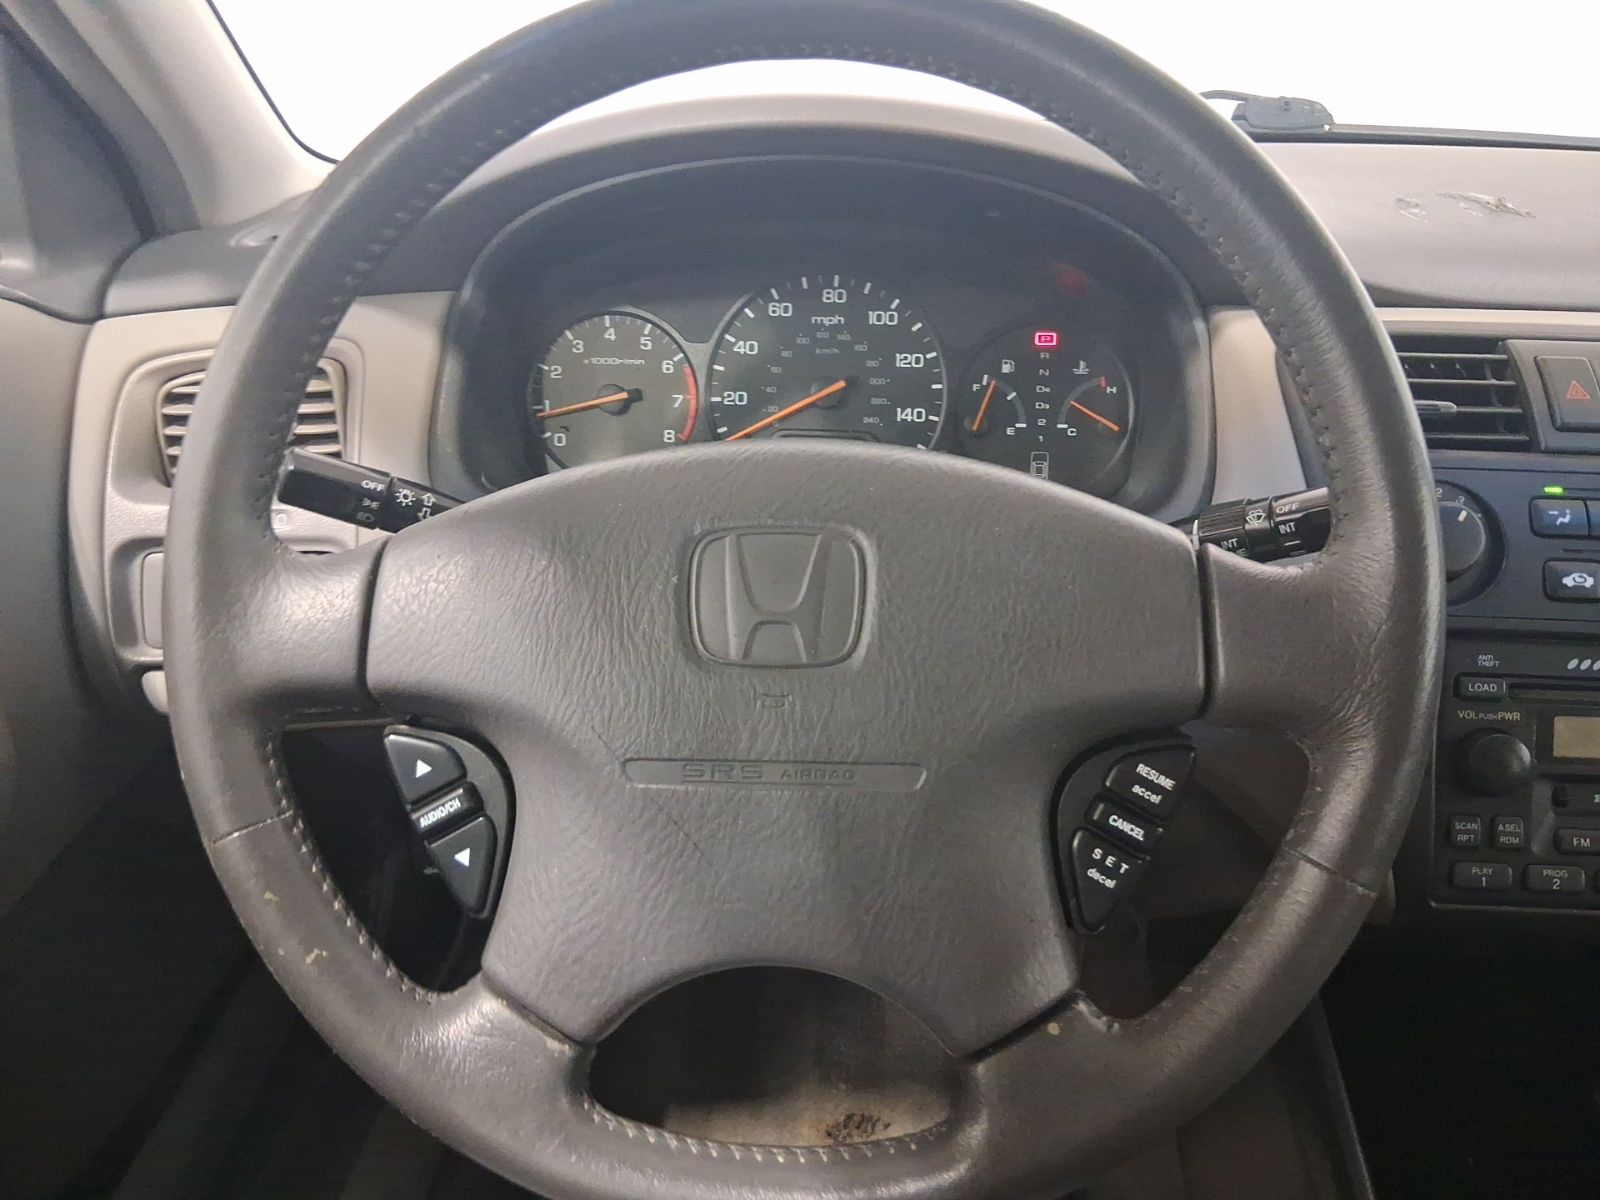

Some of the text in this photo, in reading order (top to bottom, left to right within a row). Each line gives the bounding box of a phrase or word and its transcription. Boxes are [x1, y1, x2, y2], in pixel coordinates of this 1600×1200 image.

[822, 289, 847, 303] 80
[768, 303, 793, 317] 60
[811, 315, 845, 327] mph
[868, 311, 898, 326] 100
[604, 327, 616, 341] 4
[572, 340, 584, 353] 3
[639, 337, 652, 350] 5
[733, 341, 758, 355] 40
[895, 354, 924, 368] 120
[1040, 352, 1050, 360] R
[550, 366, 562, 379] 2
[662, 360, 674, 374] 6
[972, 384, 982, 392] F
[1106, 386, 1117, 394] H
[672, 395, 683, 408] 7
[723, 392, 748, 405] 20
[545, 400, 550, 413] 1
[1035, 402, 1050, 410] D3
[896, 408, 926, 422] 140
[1037, 418, 1047, 426] 2
[663, 430, 675, 443] 8
[1006, 427, 1016, 436] E
[1067, 428, 1077, 436] C
[554, 433, 566, 446] 0
[1038, 435, 1044, 443] 1
[362, 480, 385, 492] OFF
[1435, 488, 1443, 498] 2
[1276, 502, 1300, 514] OFF
[1278, 521, 1296, 534] INT
[1221, 538, 1238, 550] INT
[1478, 660, 1500, 668] THEFT
[1468, 683, 1497, 692] LOAD
[1458, 710, 1479, 720] VOL
[1498, 712, 1520, 721] PWR
[682, 763, 855, 781] SRS AIRBAG
[1136, 763, 1176, 791] RESUME
[1131, 784, 1163, 804] accel
[419, 797, 461, 828] AUDIO/CH
[1108, 814, 1145, 841] CANCEL
[1455, 822, 1478, 830] SCAN
[1457, 834, 1475, 842] RPT
[1500, 836, 1520, 845] RDM
[1573, 837, 1591, 848] FM
[1472, 867, 1493, 875] PLAY
[1543, 868, 1568, 878] PROG
[1086, 867, 1117, 889] decel
[1482, 877, 1487, 887] 1
[1552, 879, 1561, 890] 2
